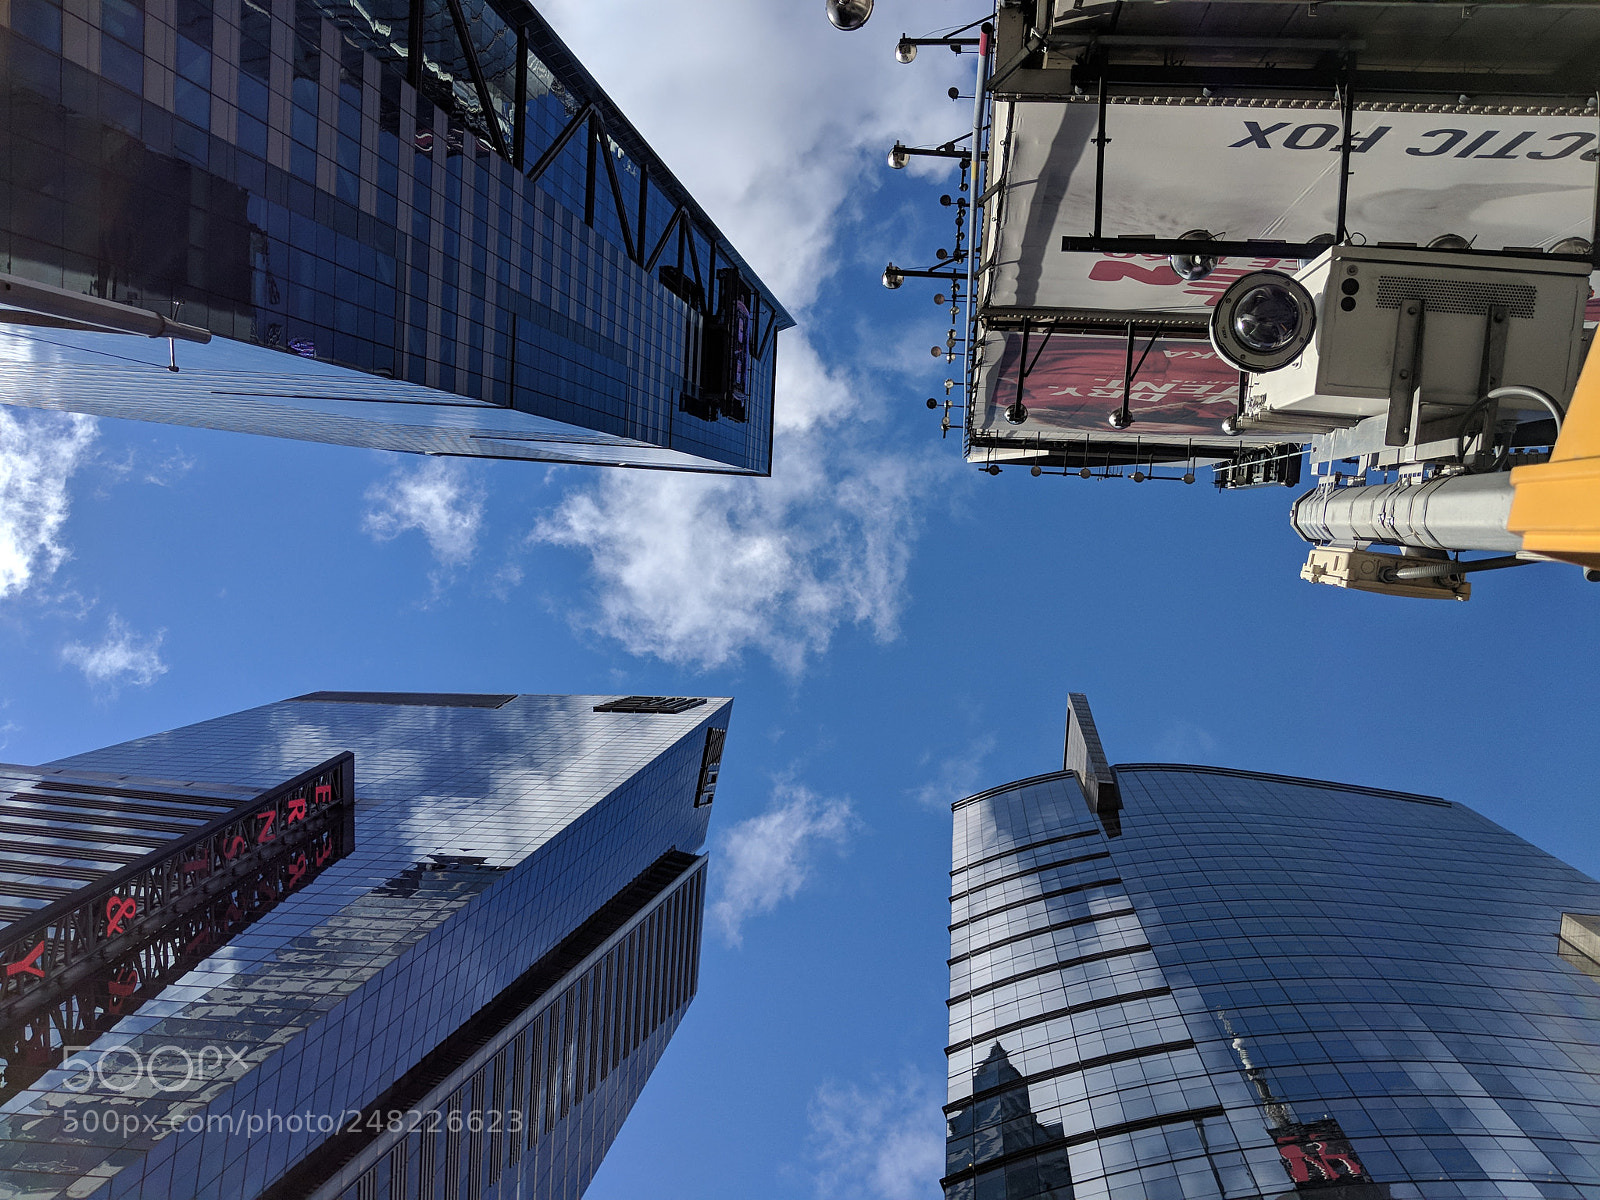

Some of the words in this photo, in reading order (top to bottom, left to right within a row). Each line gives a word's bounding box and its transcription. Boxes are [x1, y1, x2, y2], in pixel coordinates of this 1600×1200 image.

[1228, 121, 1393, 153] FOX
[183, 784, 332, 874] ERNST
[107, 896, 137, 938] &
